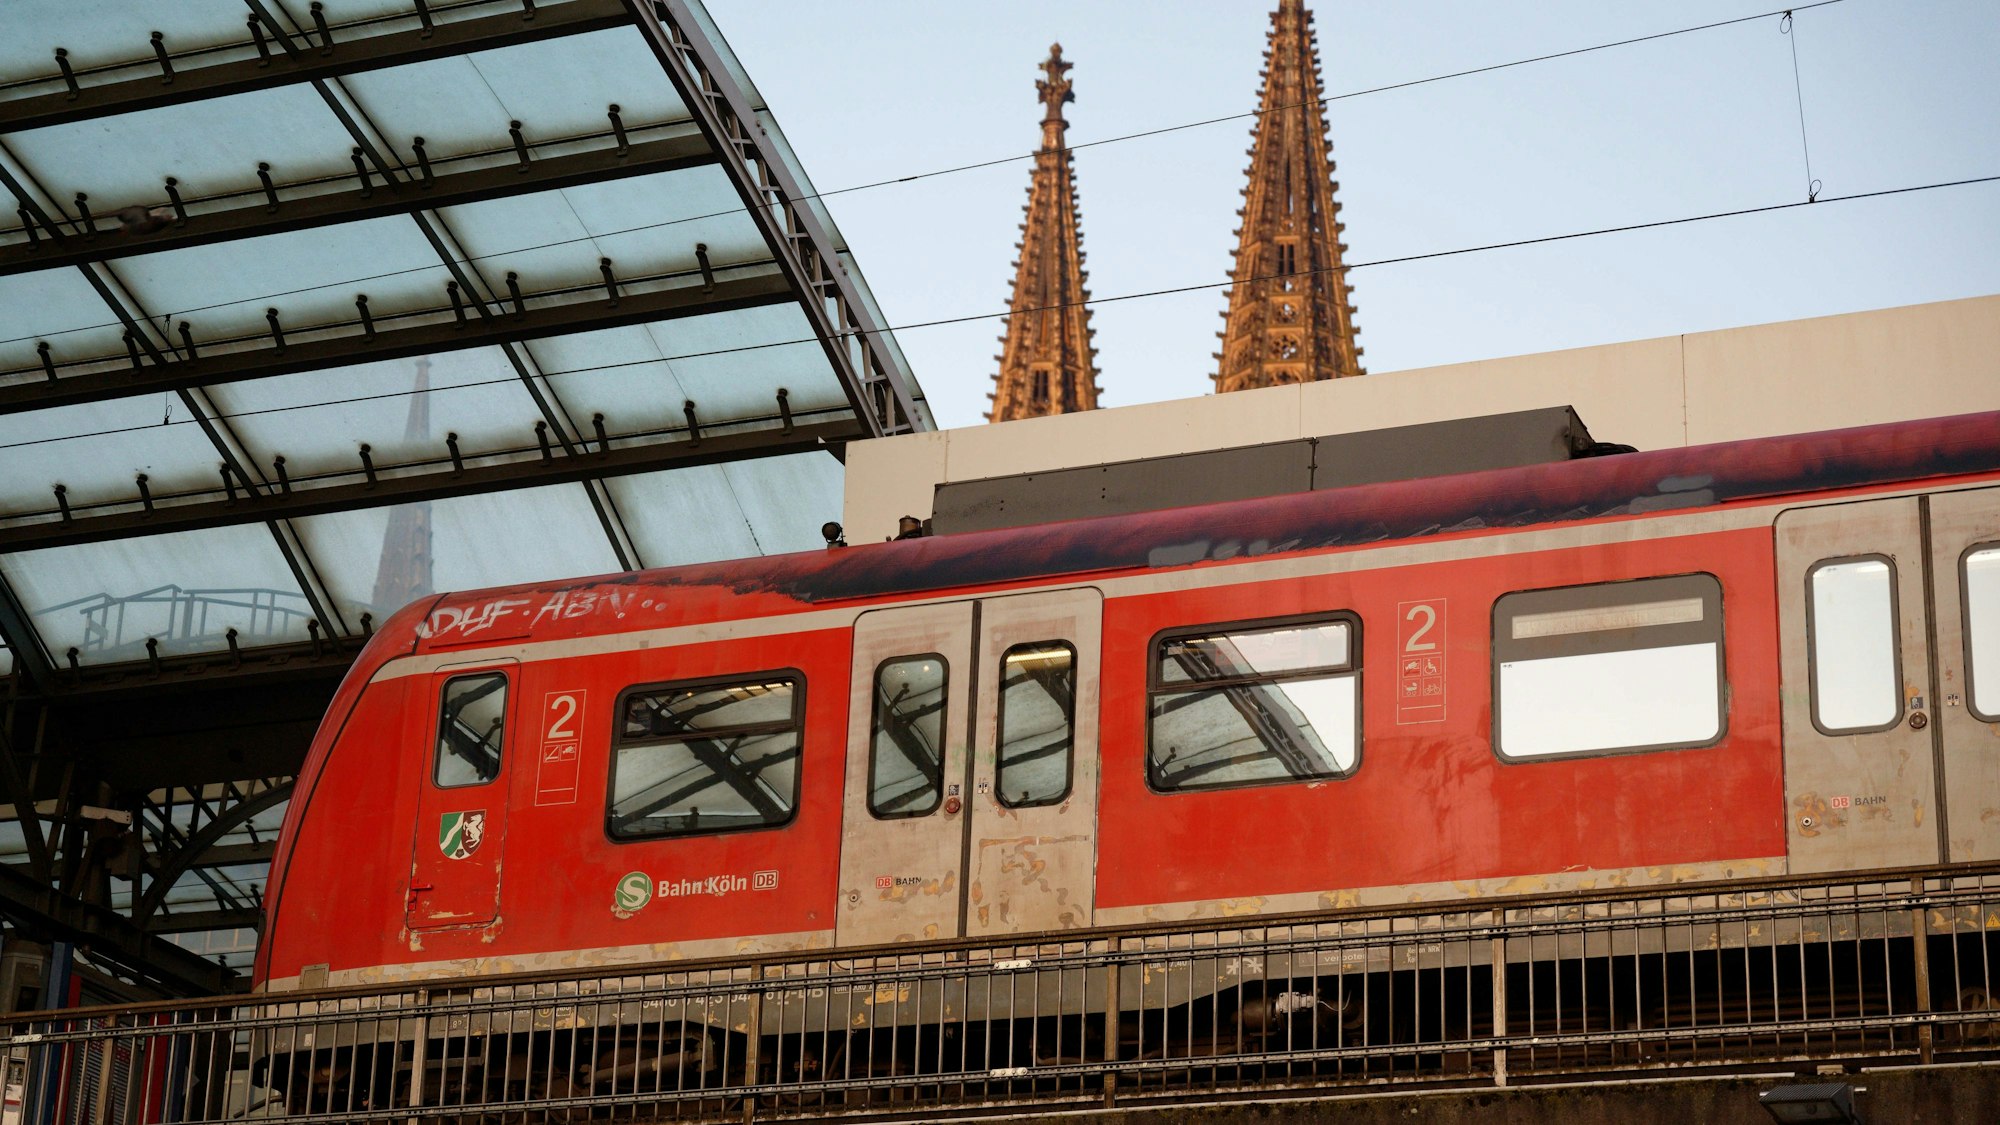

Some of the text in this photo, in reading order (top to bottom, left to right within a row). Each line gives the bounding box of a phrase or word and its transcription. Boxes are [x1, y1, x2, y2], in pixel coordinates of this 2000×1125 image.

[1406, 605, 1436, 652] 2
[548, 695, 577, 739] 2
[1832, 796, 1887, 808] DB BAHN
[621, 873, 776, 908] S Bahn Köln DB
[877, 876, 922, 888] DB BAHN
